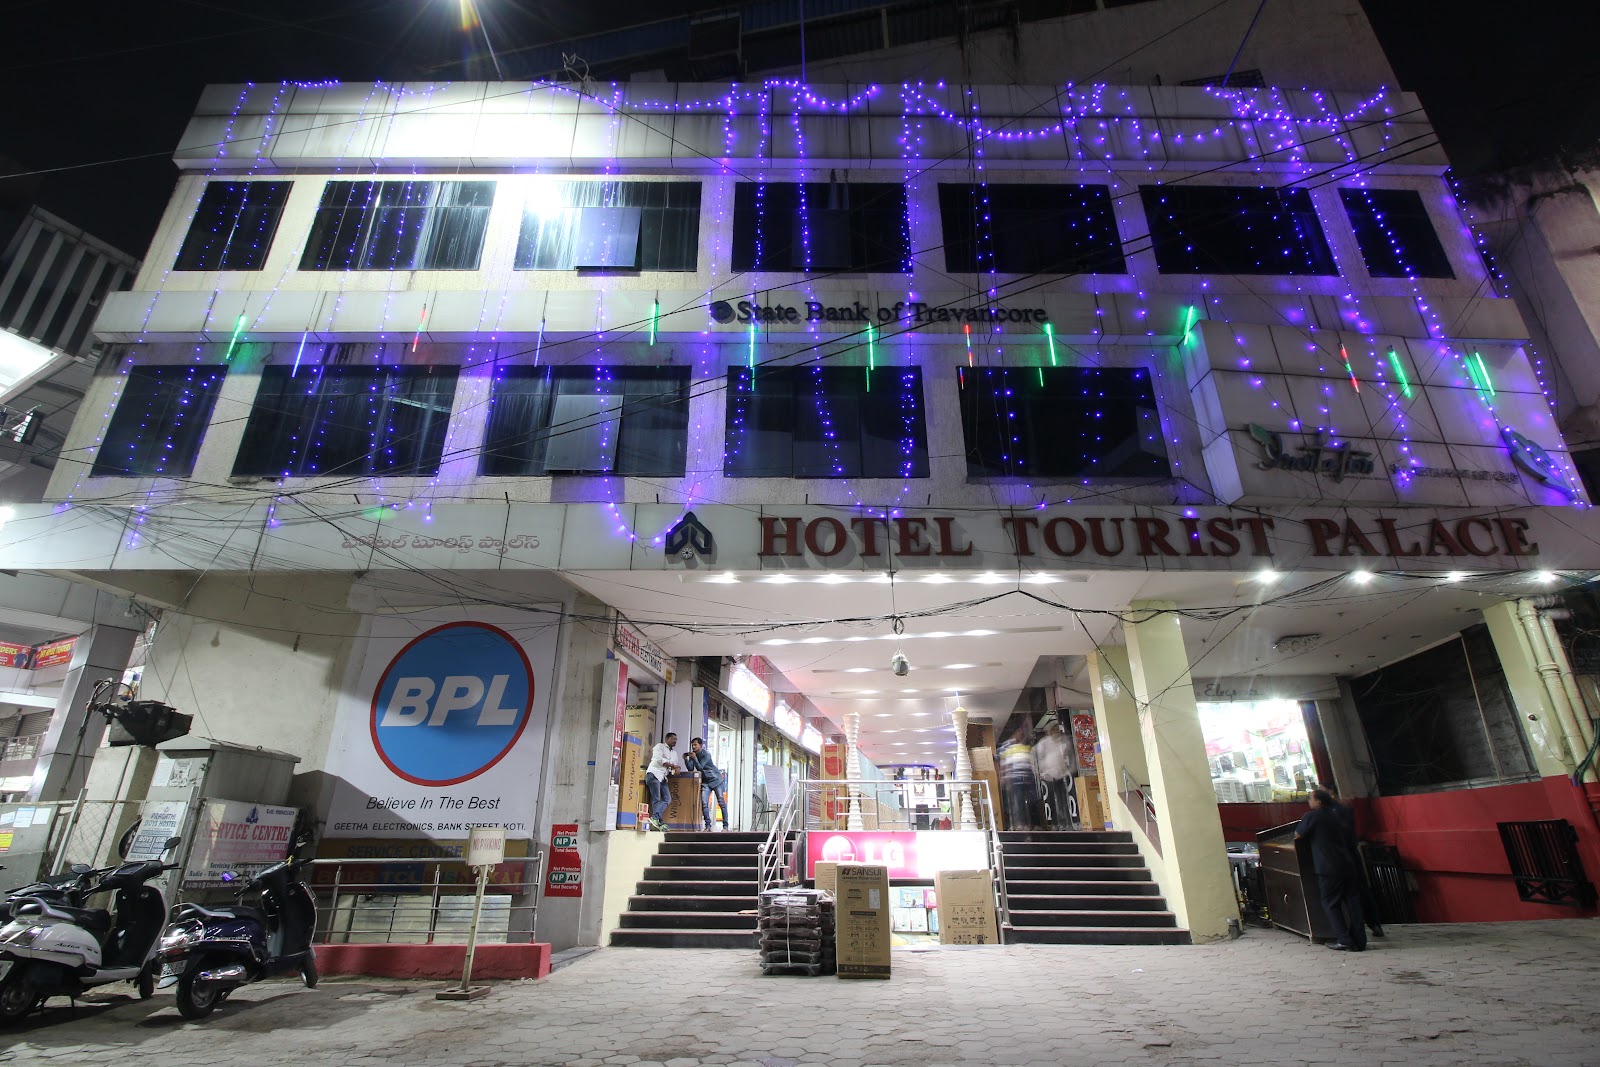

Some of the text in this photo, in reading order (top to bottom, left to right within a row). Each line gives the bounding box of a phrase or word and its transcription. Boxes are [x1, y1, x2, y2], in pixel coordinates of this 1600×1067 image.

[736, 301, 1048, 323] State Bank of Travancore
[757, 516, 1540, 558] HOTEL TOURIST PALACE
[380, 674, 519, 727] BPL
[628, 750, 636, 801] Whirlpool
[366, 795, 501, 810] Believe In The Best
[669, 780, 681, 819] Whirlpool
[206, 821, 291, 841] ERVICE CENTRE
[334, 823, 368, 831] GEETHA
[372, 823, 435, 832] ELECTRONICS,
[437, 823, 462, 831] BANK
[503, 823, 526, 831] KOTI.
[346, 845, 464, 858] SERVICE CENTRE
[480, 838, 501, 850] PARKING
[864, 841, 905, 868] LG
[568, 874, 579, 882] AV
[852, 867, 882, 876] SANSUI
[54, 942, 81, 950] Activa
